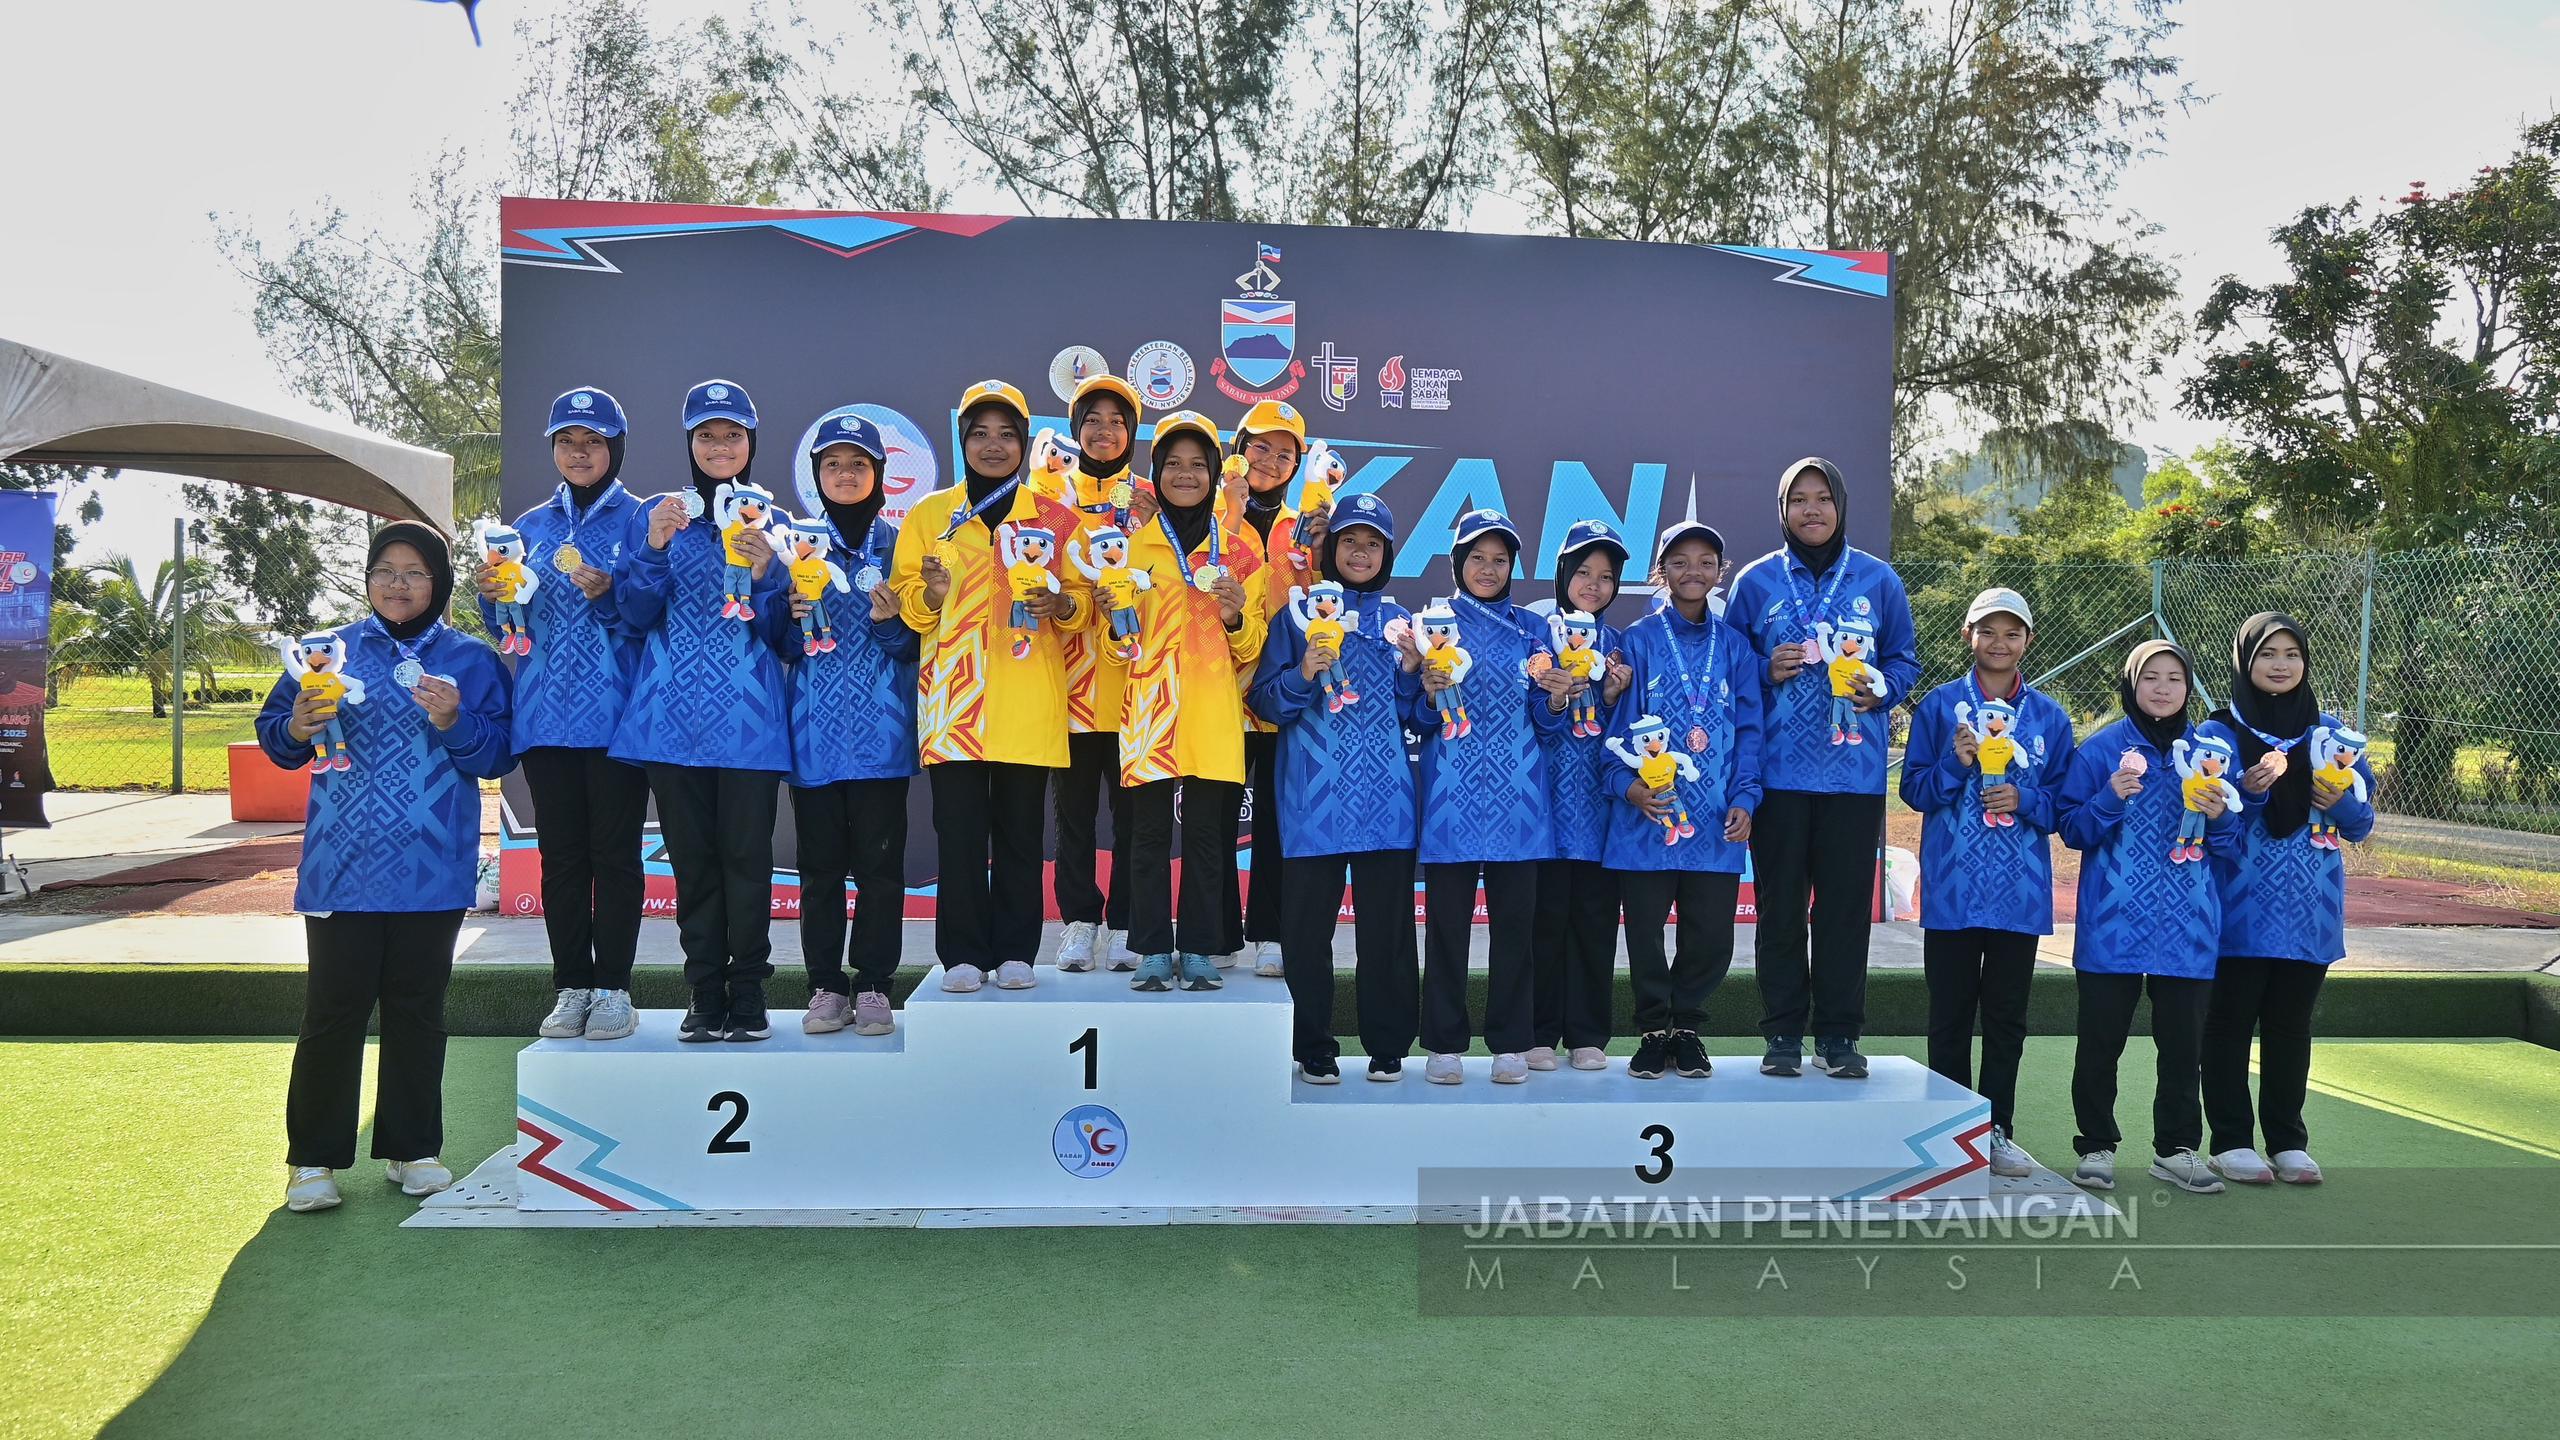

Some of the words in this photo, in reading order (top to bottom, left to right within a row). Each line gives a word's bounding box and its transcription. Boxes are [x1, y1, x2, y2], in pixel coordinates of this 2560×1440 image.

[1131, 343, 1178, 368] KEMENTERIAN
[1179, 352, 1193, 373] BELIA
[1411, 369, 1461, 380] LEMBAGA
[1185, 377, 1194, 392] DAN
[1219, 381, 1246, 400] SABAH
[1276, 383, 1296, 399] JAYA
[1412, 380, 1447, 389] SUKAN
[1160, 393, 1185, 408] SUKAN
[1412, 390, 1447, 399] SABAH
[3, 729, 28, 738] 2025
[1069, 1028, 1098, 1090] 1
[707, 1091, 751, 1154] 2
[1634, 1124, 1675, 1184] 3
